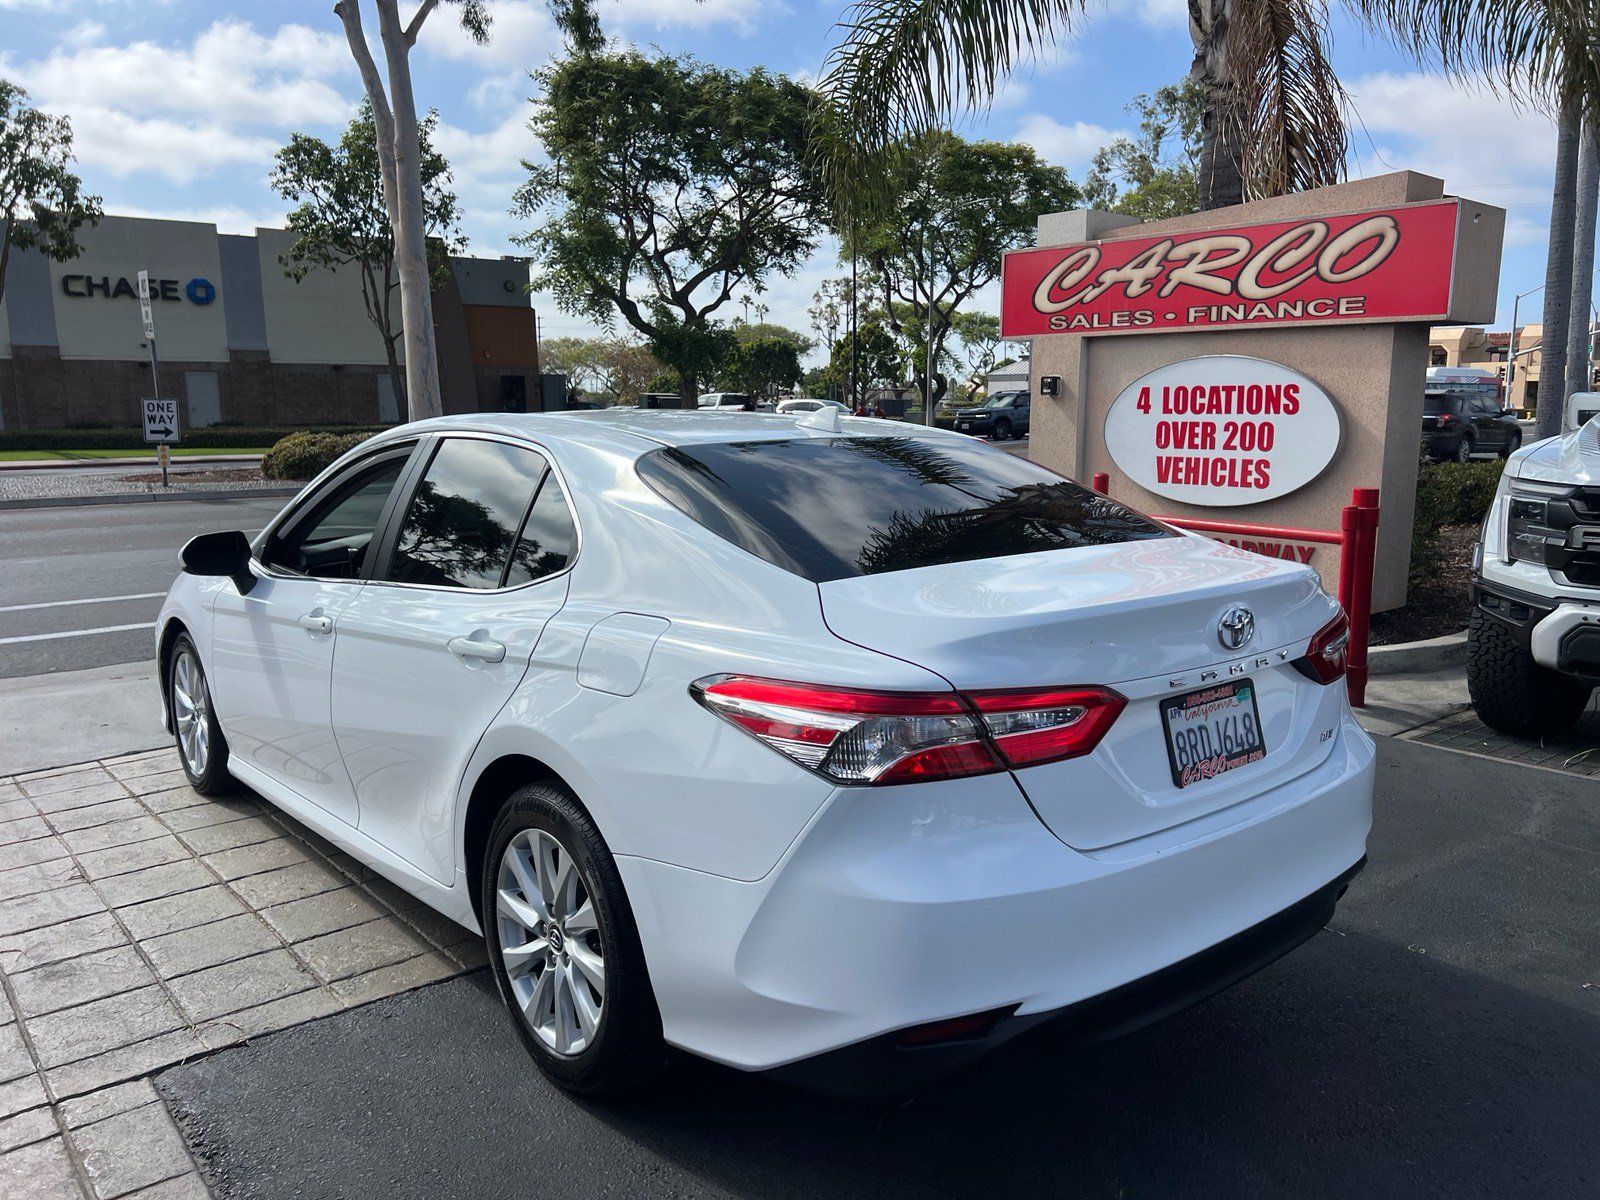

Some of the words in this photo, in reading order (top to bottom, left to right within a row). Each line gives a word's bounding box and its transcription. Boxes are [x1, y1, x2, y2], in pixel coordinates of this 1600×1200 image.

[1033, 215, 1401, 314] CARCO
[1048, 309, 1154, 331] SALES
[1186, 296, 1366, 324] FINANCE
[147, 402, 174, 413] ONE
[1136, 386, 1151, 415] 4
[1162, 384, 1300, 415] LOCATIONS
[147, 414, 175, 425] WAY
[1155, 421, 1217, 450] OVER
[1222, 421, 1275, 452] 200
[1156, 456, 1271, 489] VEHICLES
[1169, 650, 1288, 687] CAMRY
[1175, 712, 1256, 768] 8RDJ648
